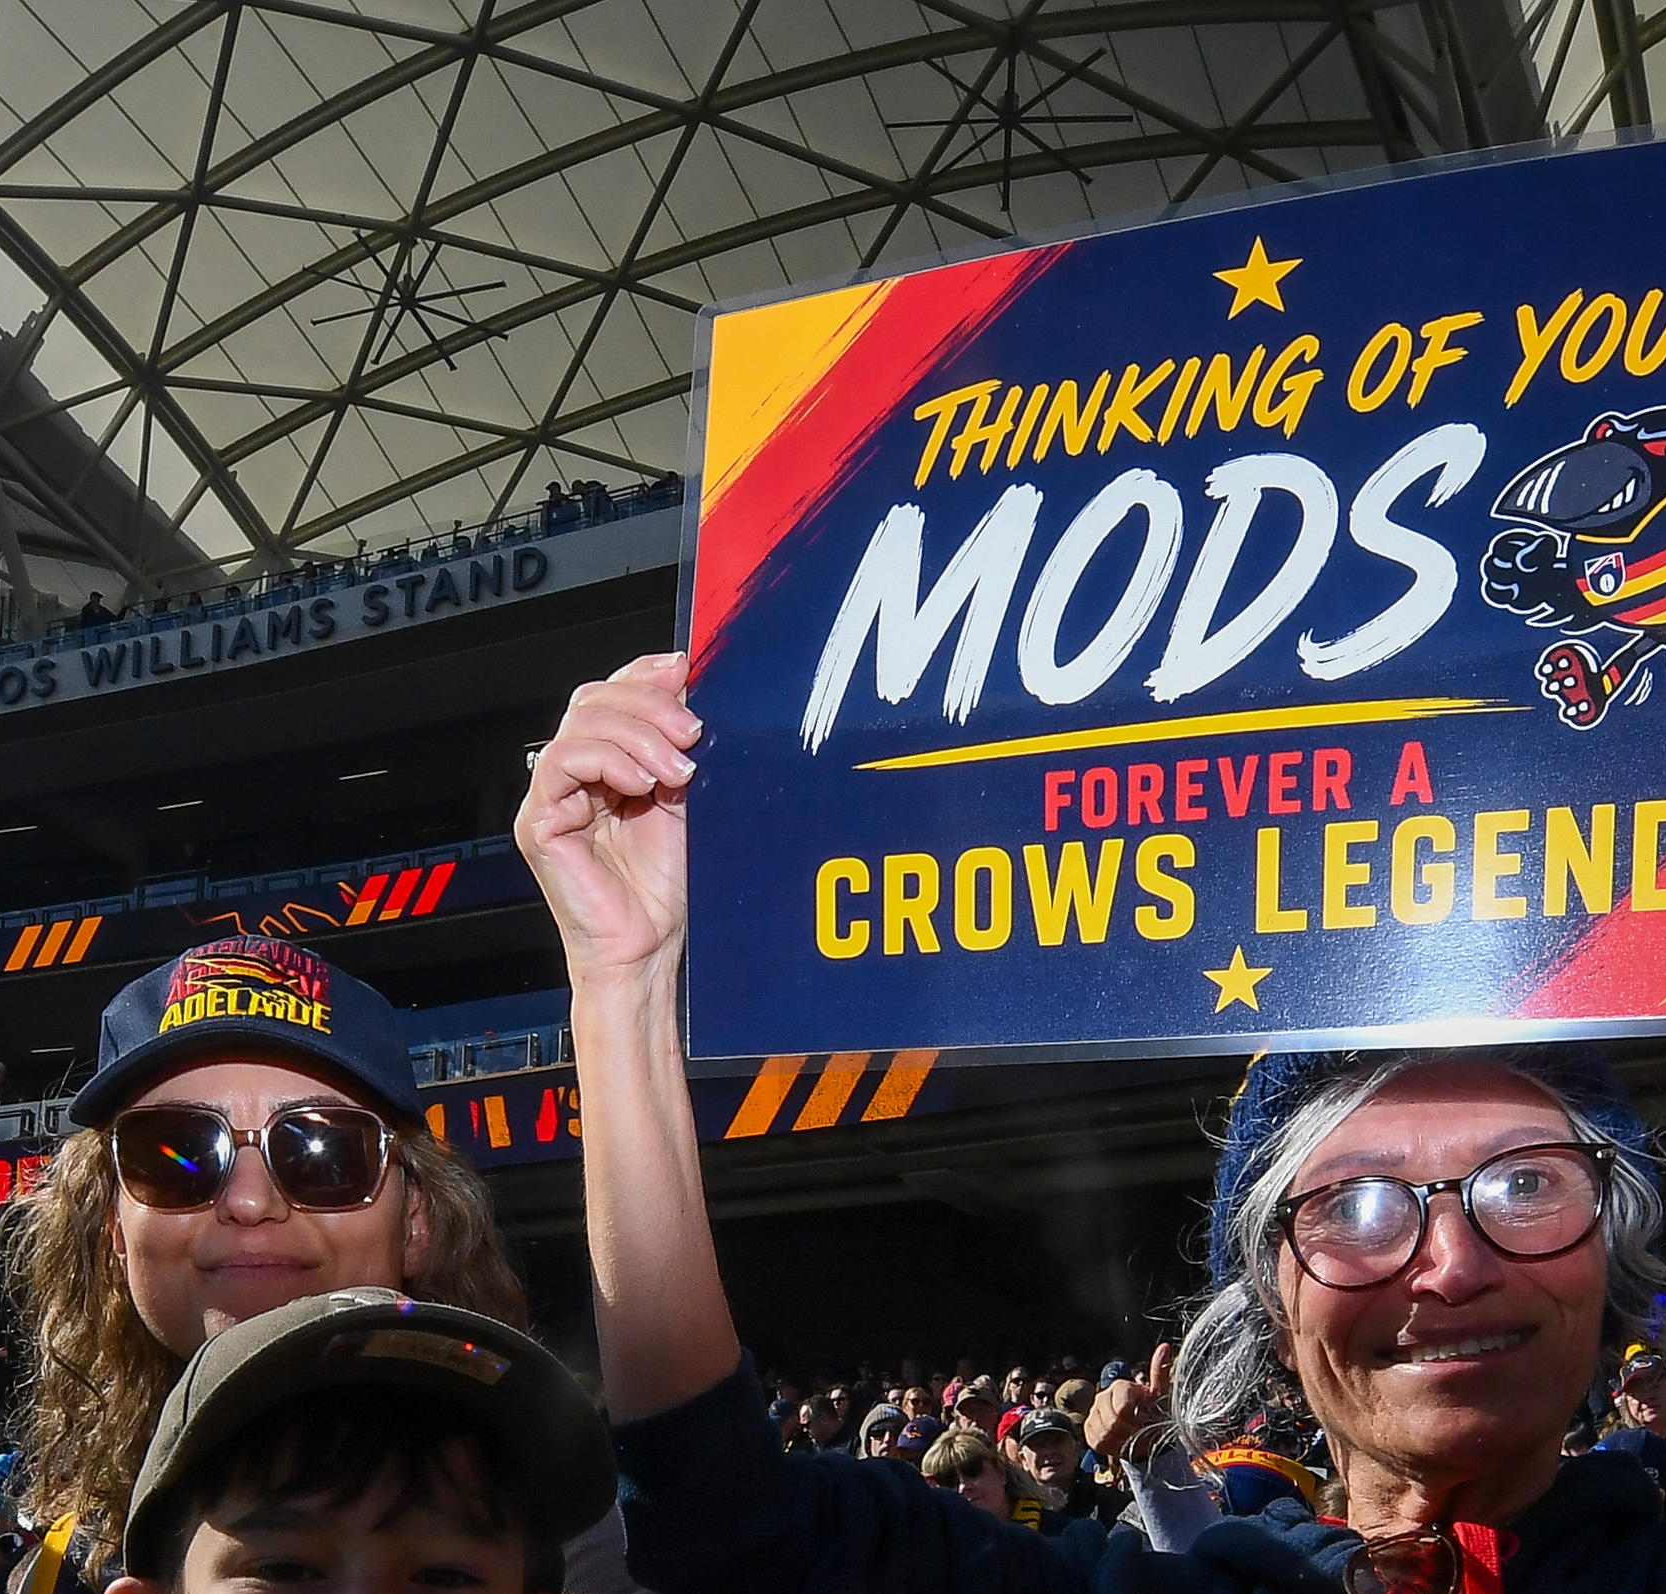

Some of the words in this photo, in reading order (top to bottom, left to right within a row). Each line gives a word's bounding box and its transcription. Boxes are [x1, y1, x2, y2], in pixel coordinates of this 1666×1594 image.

[914, 335, 1324, 486] THINKING
[1347, 312, 1483, 412] OF
[82, 597, 335, 688] WILLIAMS
[362, 545, 548, 627] STAND
[800, 424, 1486, 754] MODS
[1044, 748, 1352, 831] FOREVER
[1391, 741, 1433, 805] A
[816, 834, 1197, 960] CROWS
[159, 985, 333, 1035] ADELAIDE
